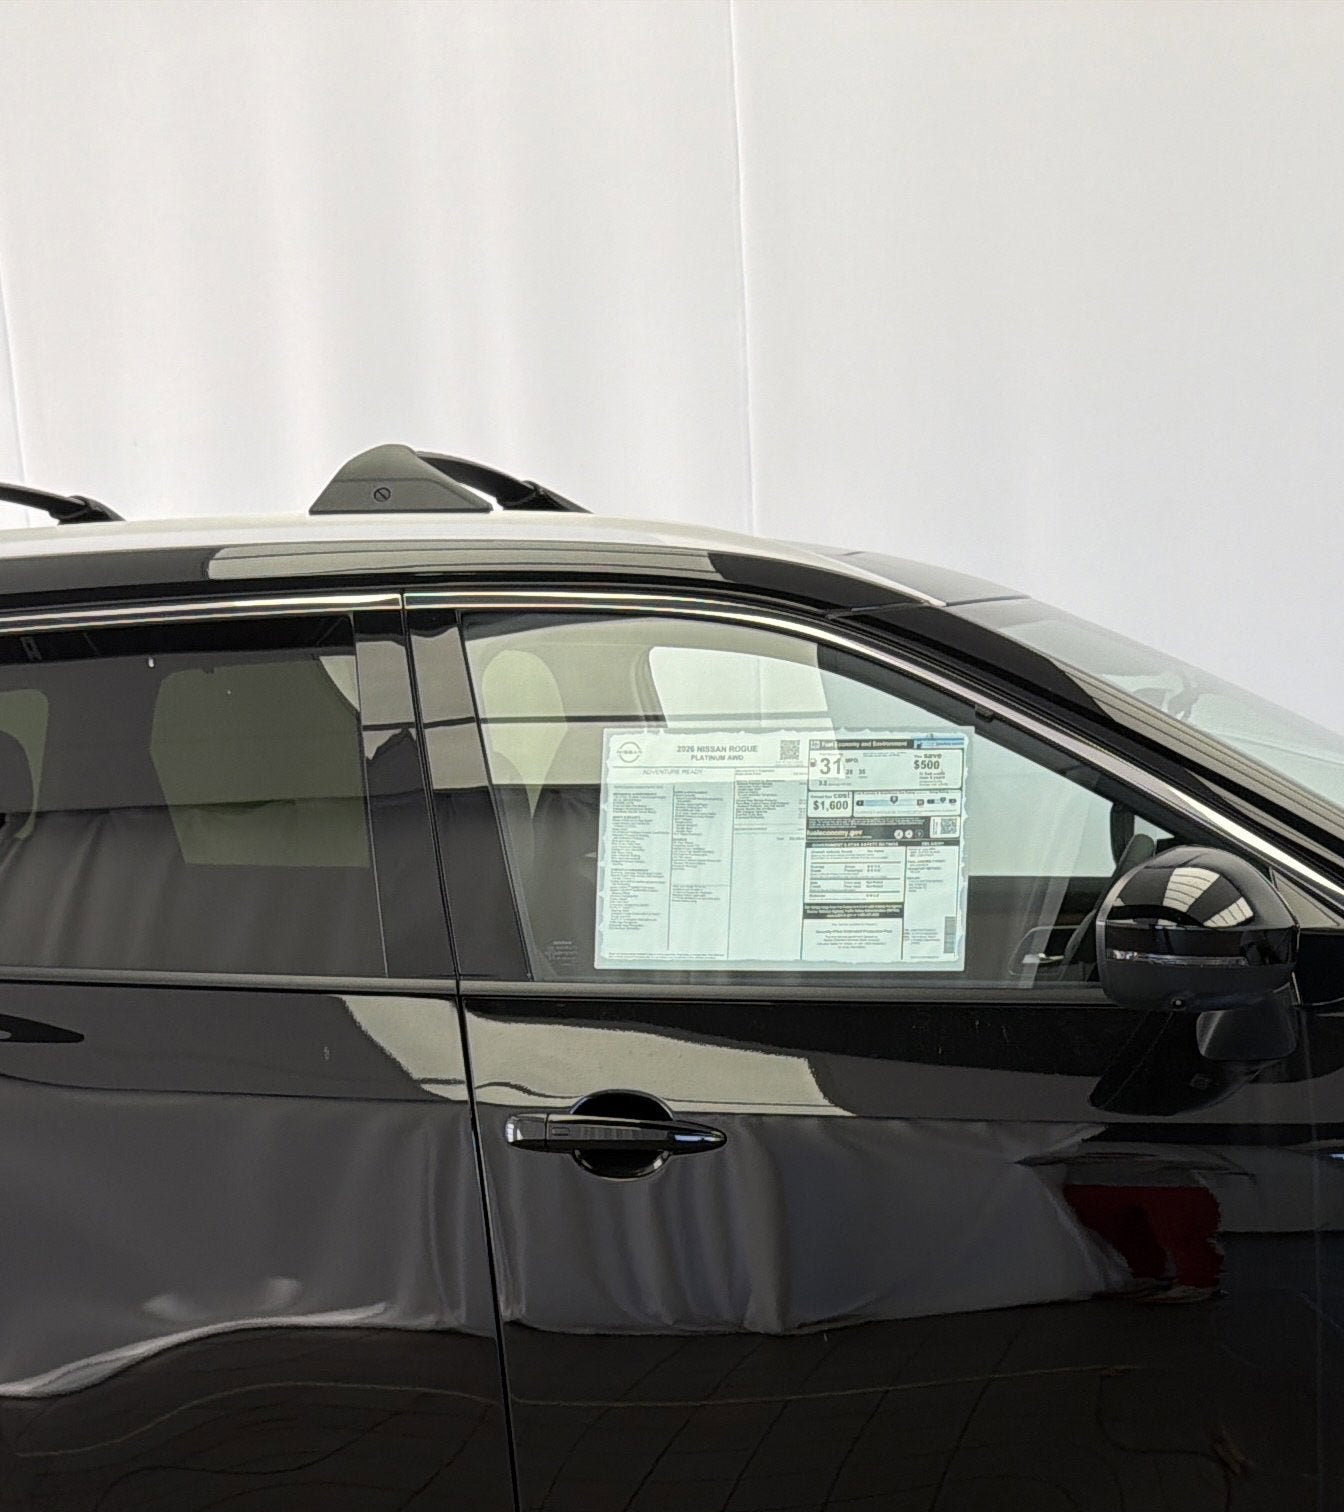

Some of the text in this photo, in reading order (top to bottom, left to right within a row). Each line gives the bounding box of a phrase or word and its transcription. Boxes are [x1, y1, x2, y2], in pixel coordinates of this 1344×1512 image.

[820, 757, 840, 775] 31
[913, 760, 940, 770] $500
[813, 800, 849, 811] $1,600
